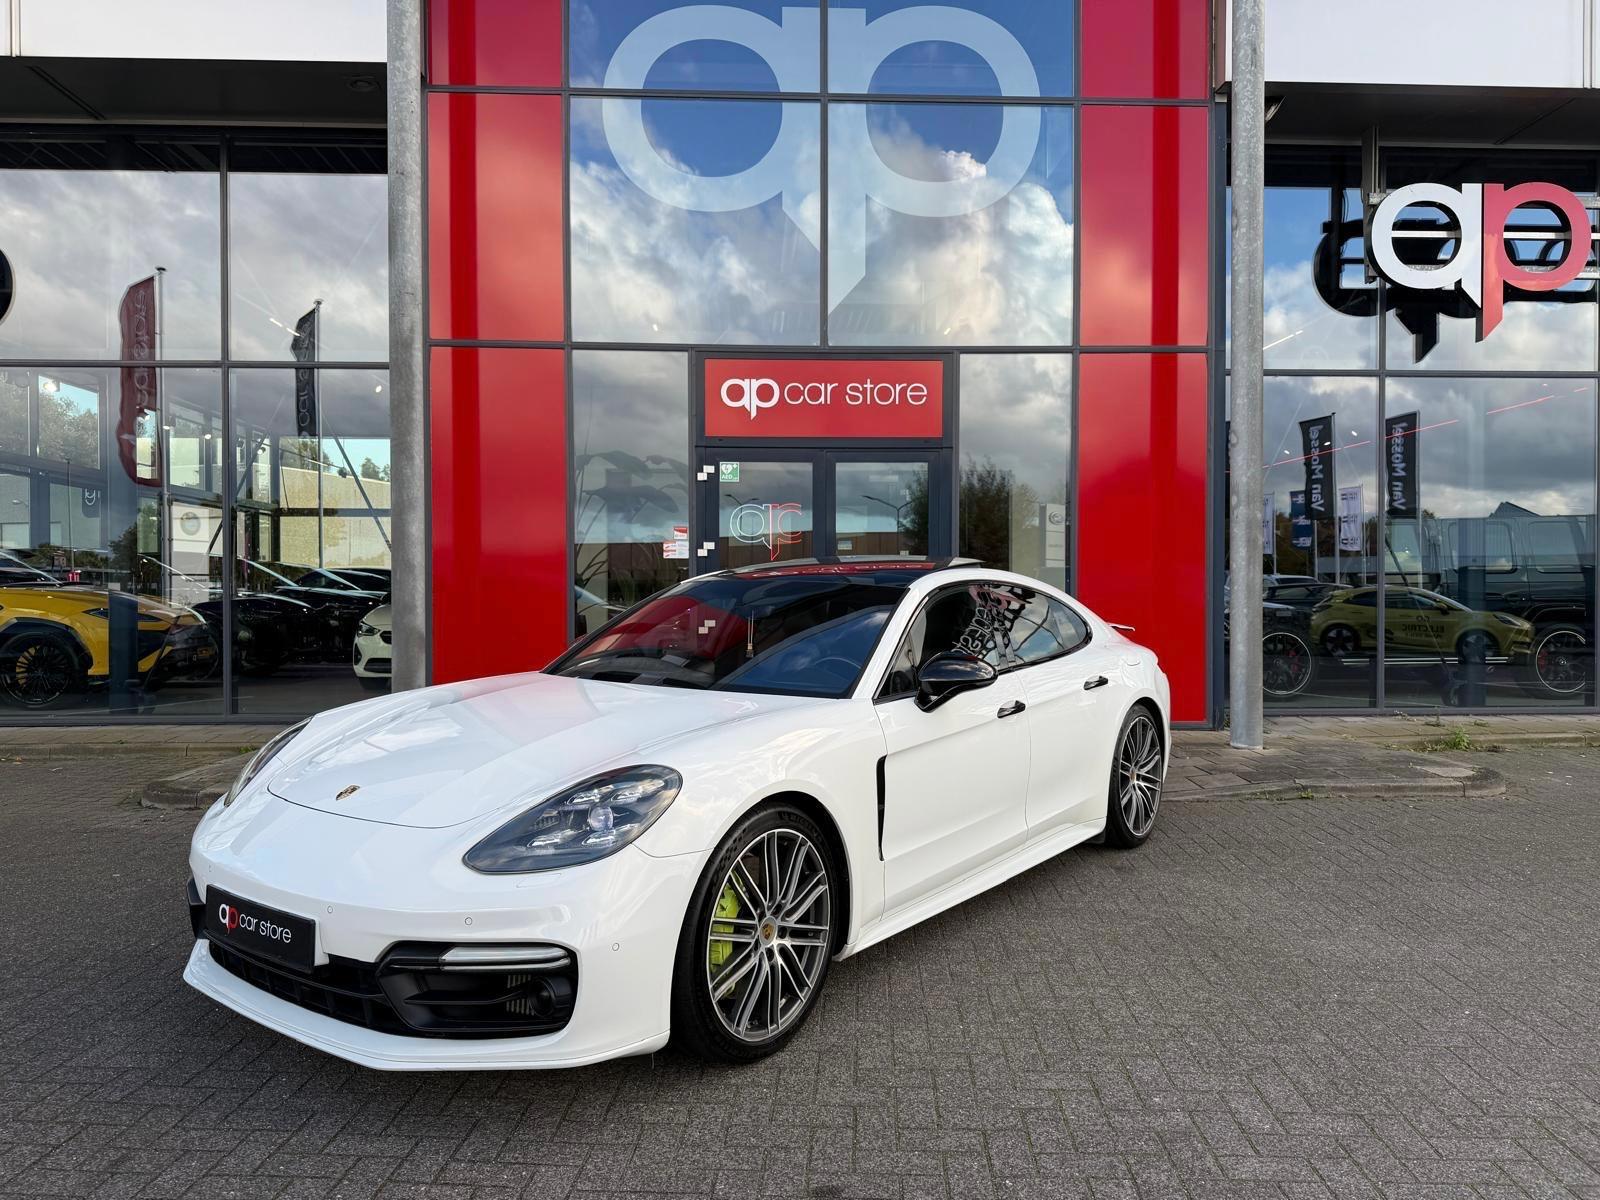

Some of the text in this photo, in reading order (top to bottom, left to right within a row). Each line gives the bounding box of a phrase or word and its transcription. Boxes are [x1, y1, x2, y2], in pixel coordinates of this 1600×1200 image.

[602, 5, 1041, 316] ap
[1371, 181, 1592, 342] ap
[720, 378, 928, 421] ap car store
[219, 903, 292, 943] ap car store
